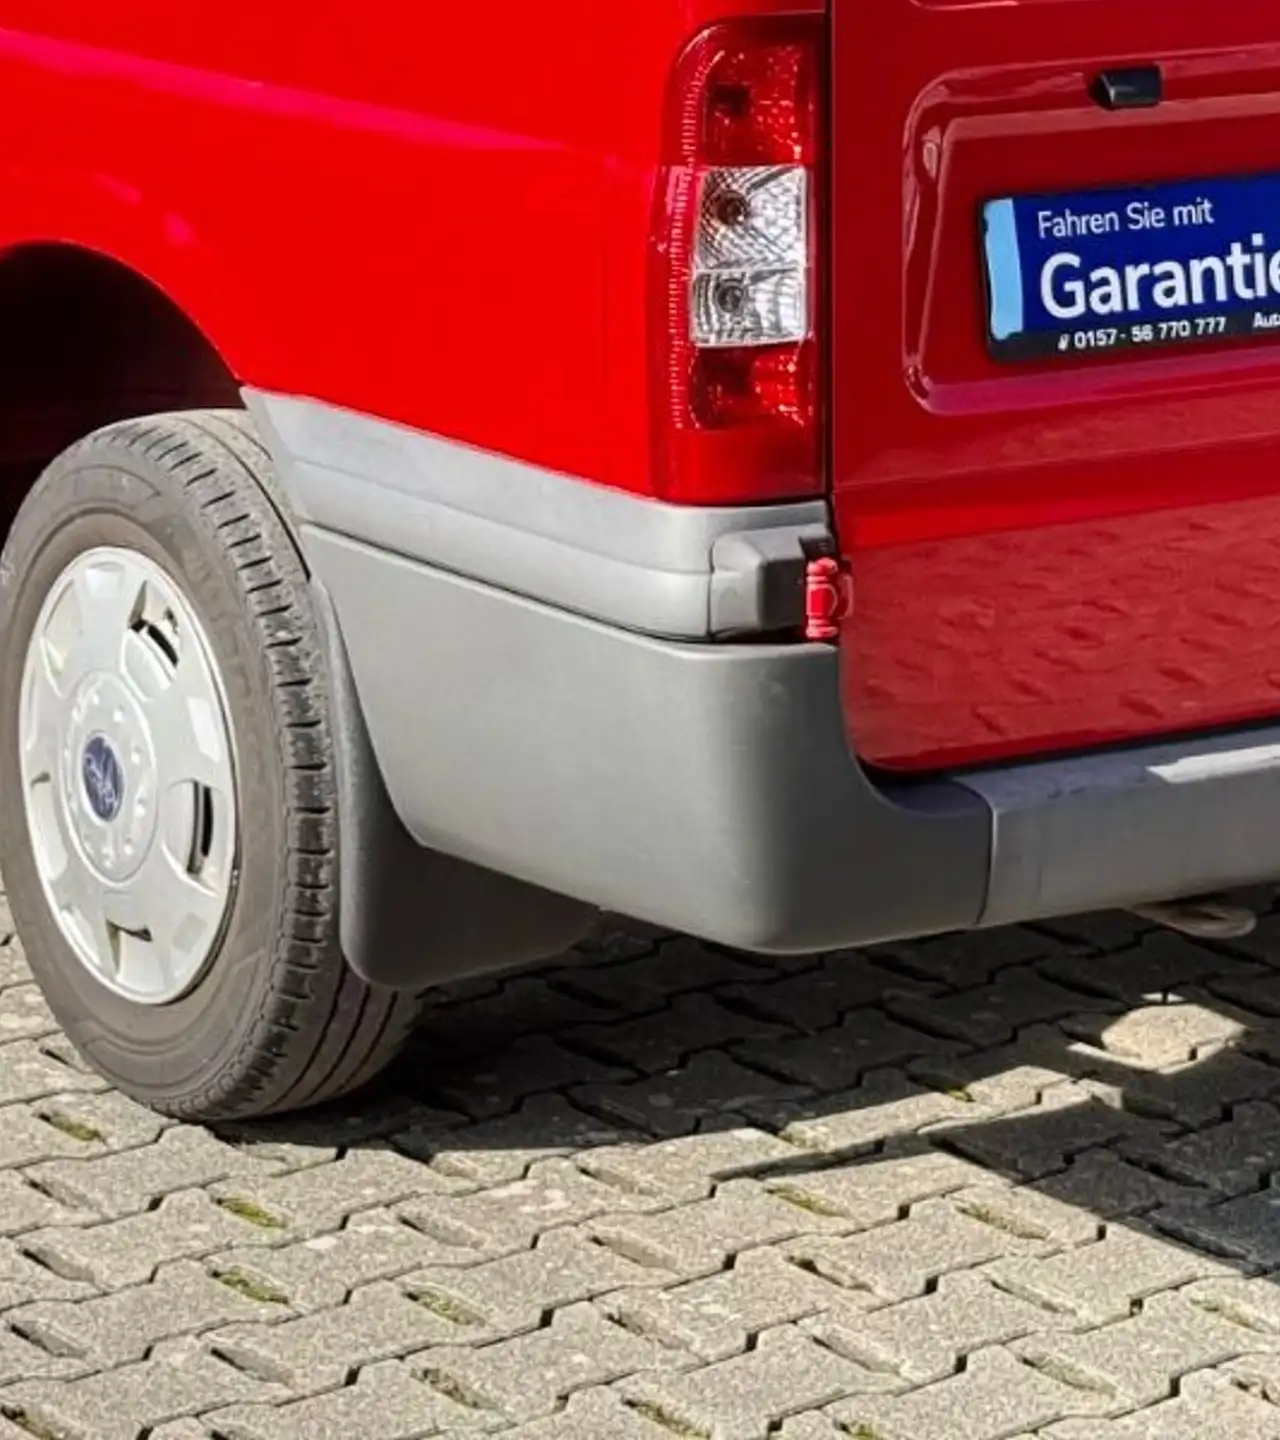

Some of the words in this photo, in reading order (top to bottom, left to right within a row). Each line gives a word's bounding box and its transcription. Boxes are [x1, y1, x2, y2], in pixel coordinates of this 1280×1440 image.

[1038, 208, 1120, 238] Fahren
[1126, 201, 1166, 230] Sie
[1173, 197, 1215, 227] mit
[1074, 329, 1118, 349] 0157
[1158, 320, 1191, 339] 770
[1195, 316, 1227, 334] 777
